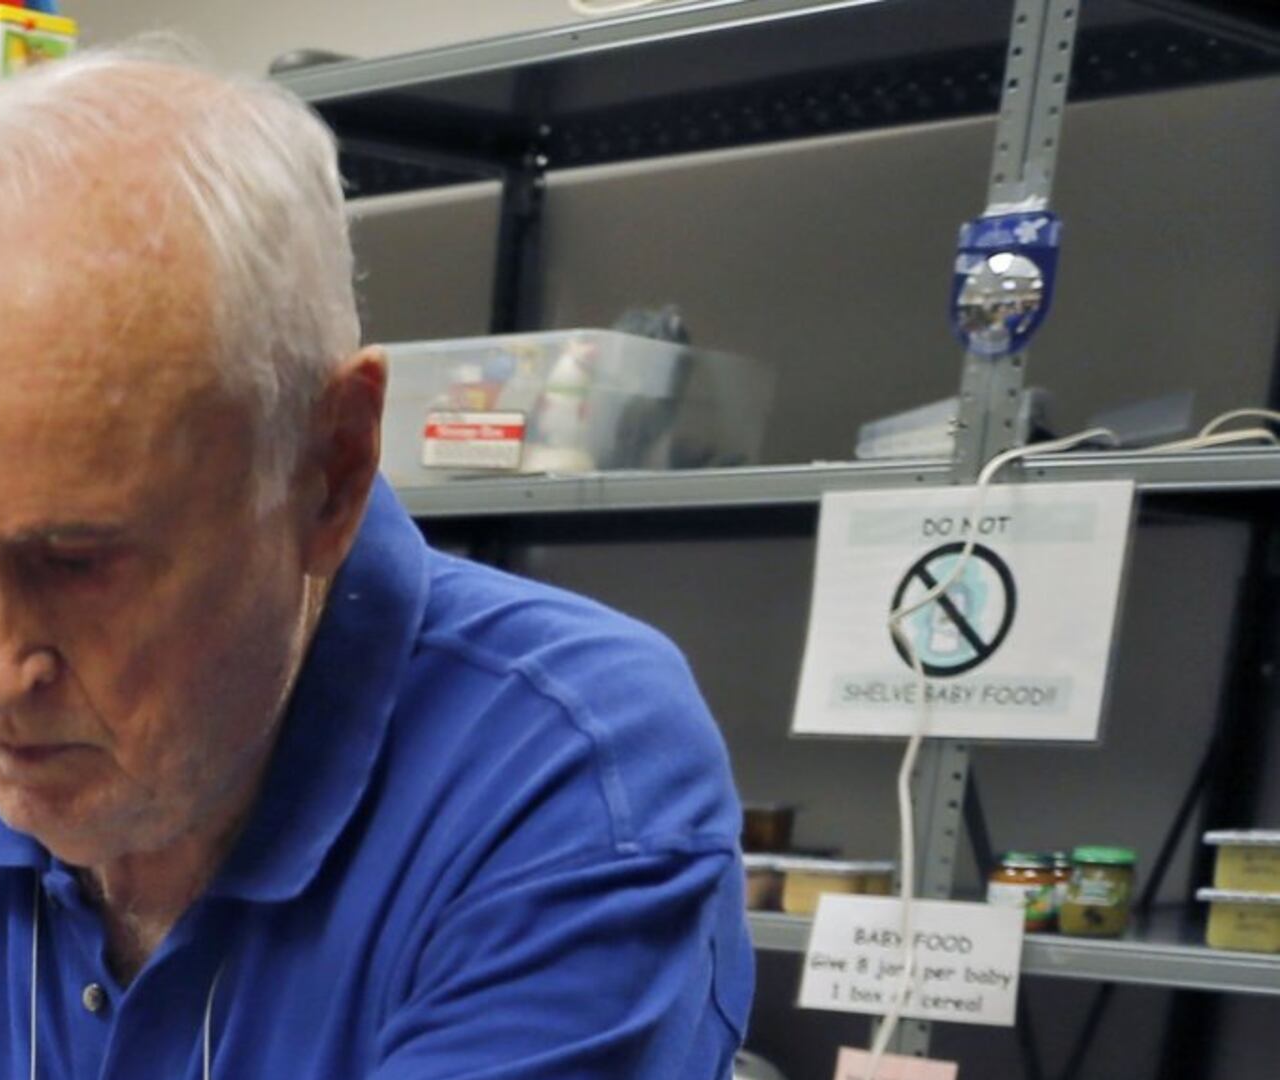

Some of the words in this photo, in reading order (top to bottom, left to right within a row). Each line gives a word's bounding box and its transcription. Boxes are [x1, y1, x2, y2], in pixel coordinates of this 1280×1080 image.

[922, 518, 953, 536] DO
[845, 682, 917, 703] SHELVE
[854, 928, 903, 946] BABY
[913, 932, 973, 954] FOOD
[811, 955, 847, 972] Give
[876, 962, 918, 981] jar
[924, 966, 954, 983] per
[965, 966, 1011, 989] baby
[921, 996, 983, 1011] cereal
